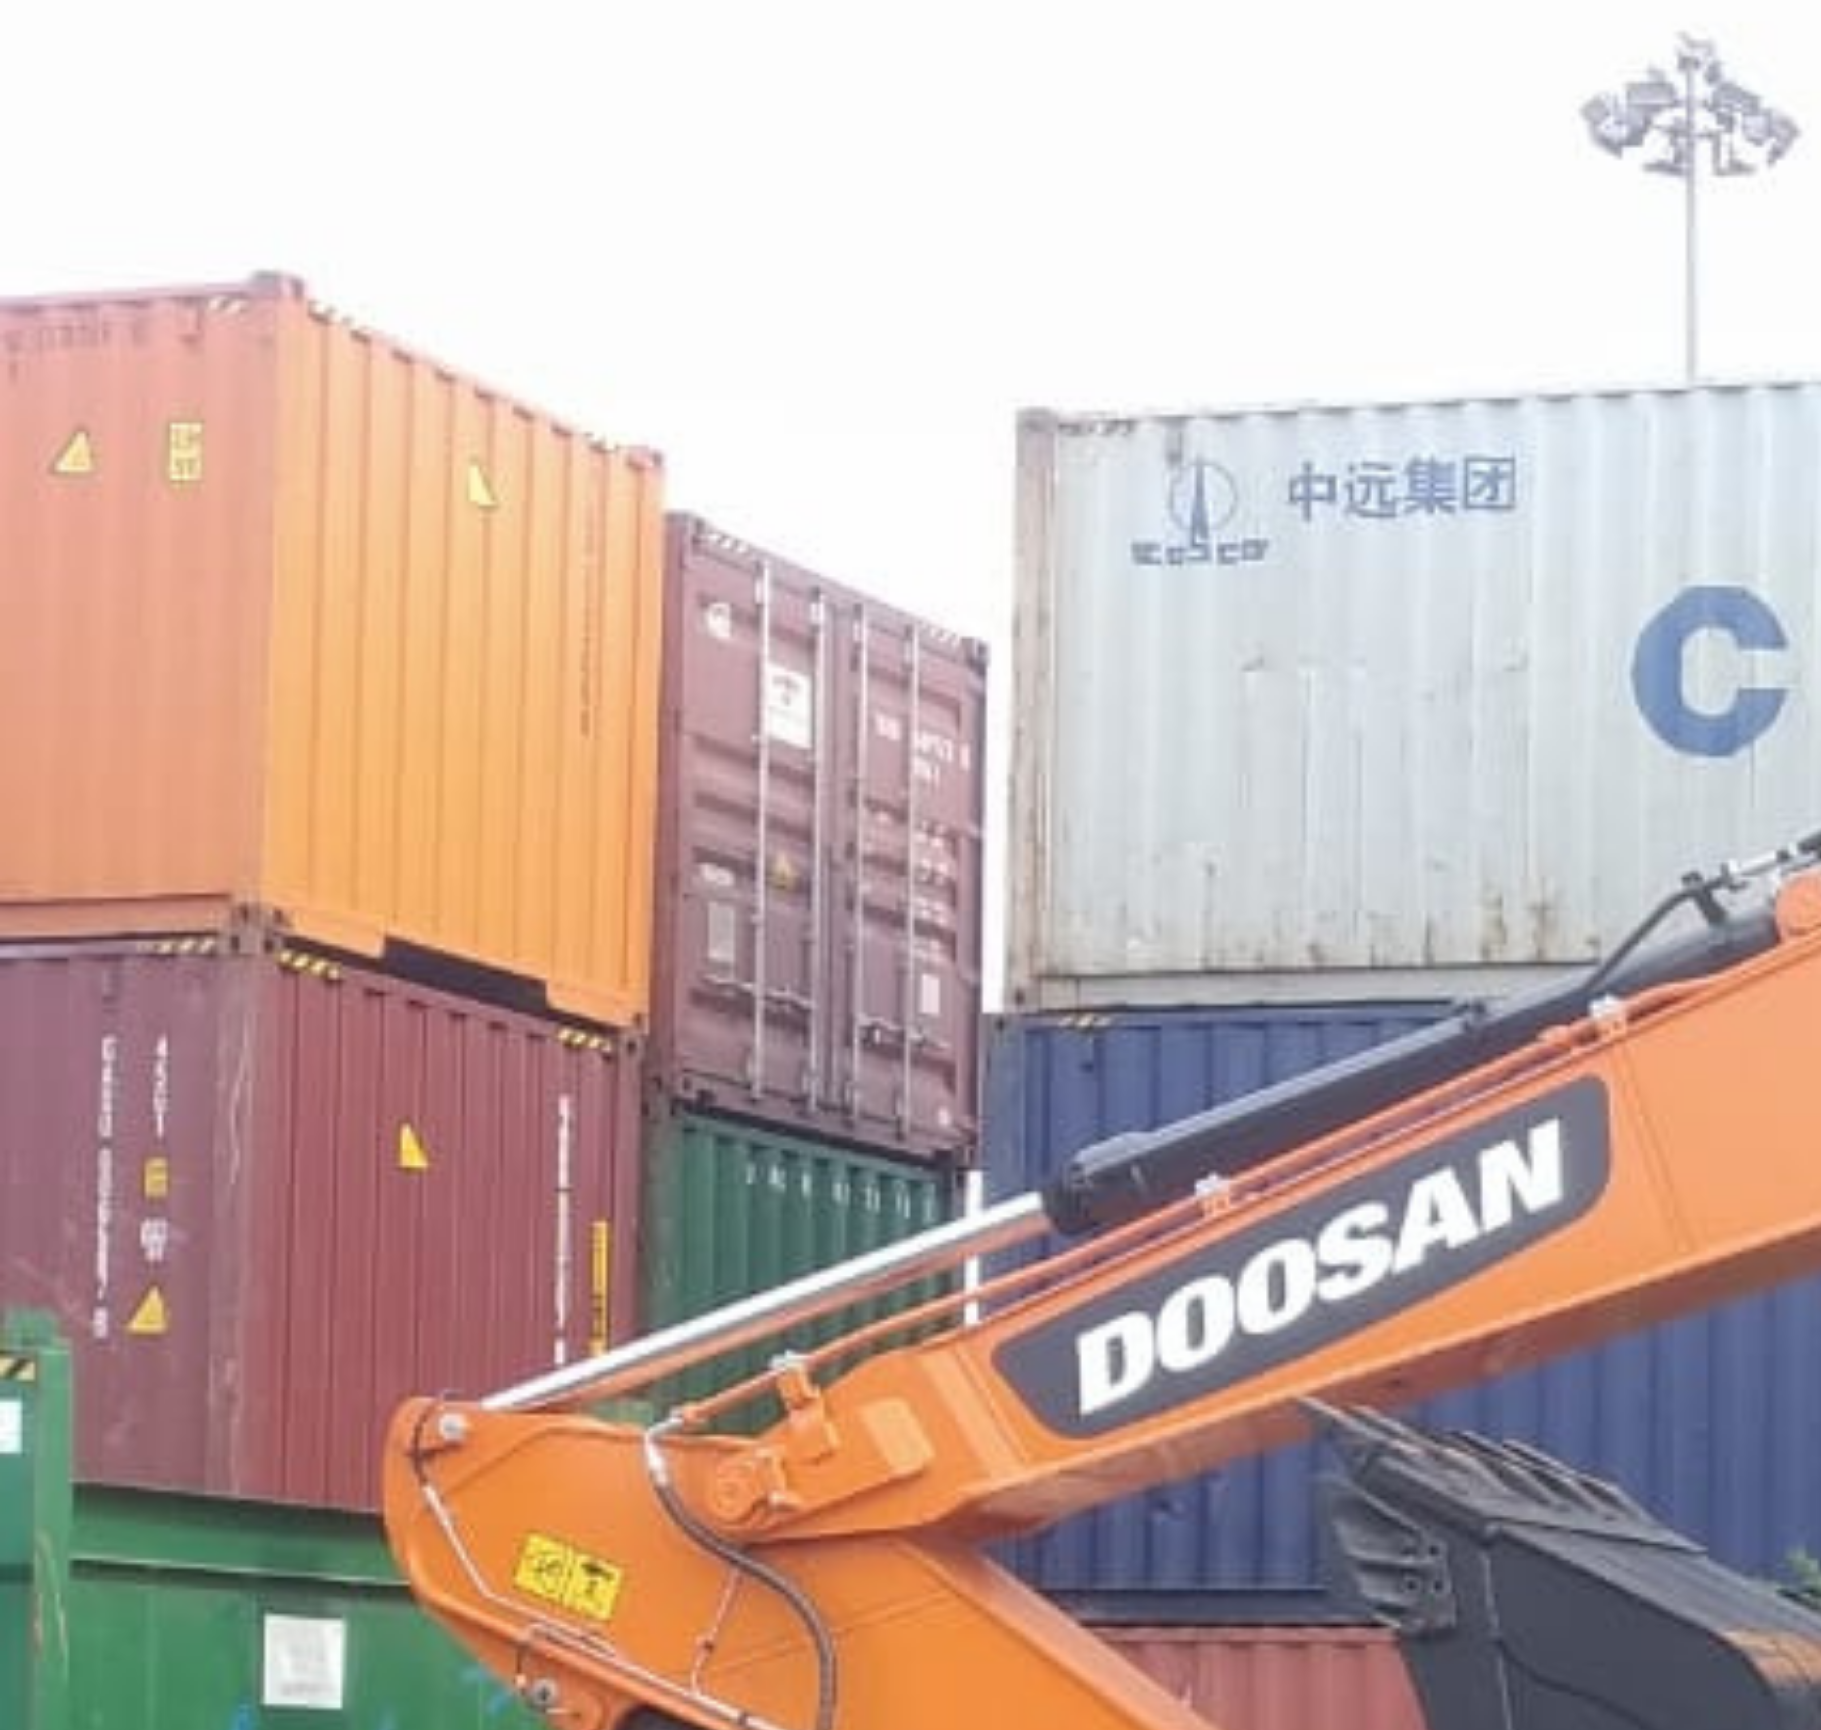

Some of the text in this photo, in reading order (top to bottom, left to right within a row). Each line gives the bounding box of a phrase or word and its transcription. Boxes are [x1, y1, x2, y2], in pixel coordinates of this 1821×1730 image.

[1288, 455, 1516, 521] 中远集团
[1076, 1117, 1564, 1417] DOOSAN
